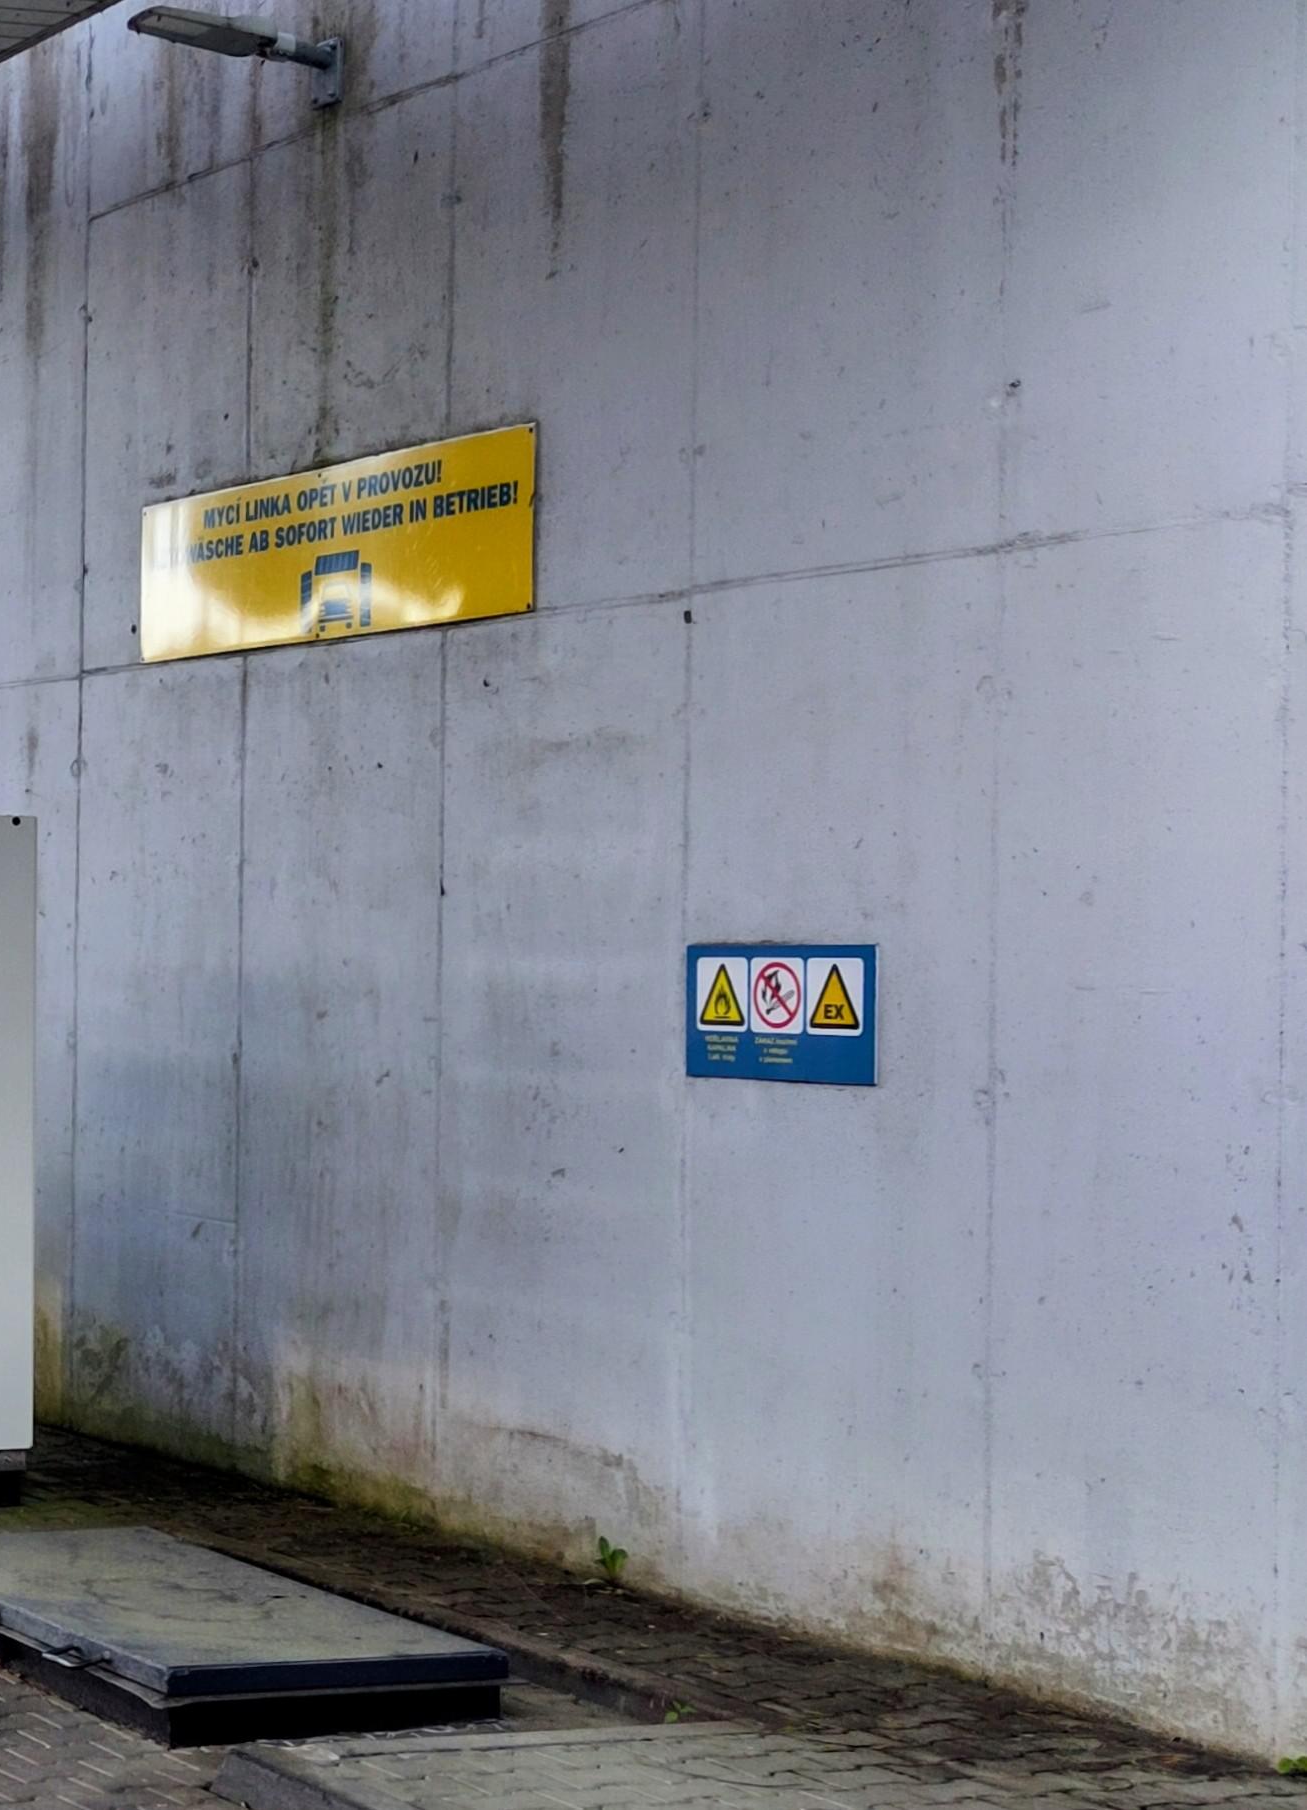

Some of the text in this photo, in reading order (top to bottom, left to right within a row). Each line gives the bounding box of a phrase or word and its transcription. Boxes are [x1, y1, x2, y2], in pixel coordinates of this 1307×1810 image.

[204, 497, 240, 529] MYCÍ
[245, 493, 291, 522] LINKA
[342, 480, 352, 503] V
[357, 459, 443, 500] PROVOZU!
[249, 529, 269, 553] AB
[275, 517, 337, 549] SOFORT
[342, 503, 404, 536] WIEDER
[409, 497, 427, 523] IN
[433, 480, 519, 519] BETRIEB!
[824, 1004, 845, 1020] EX
